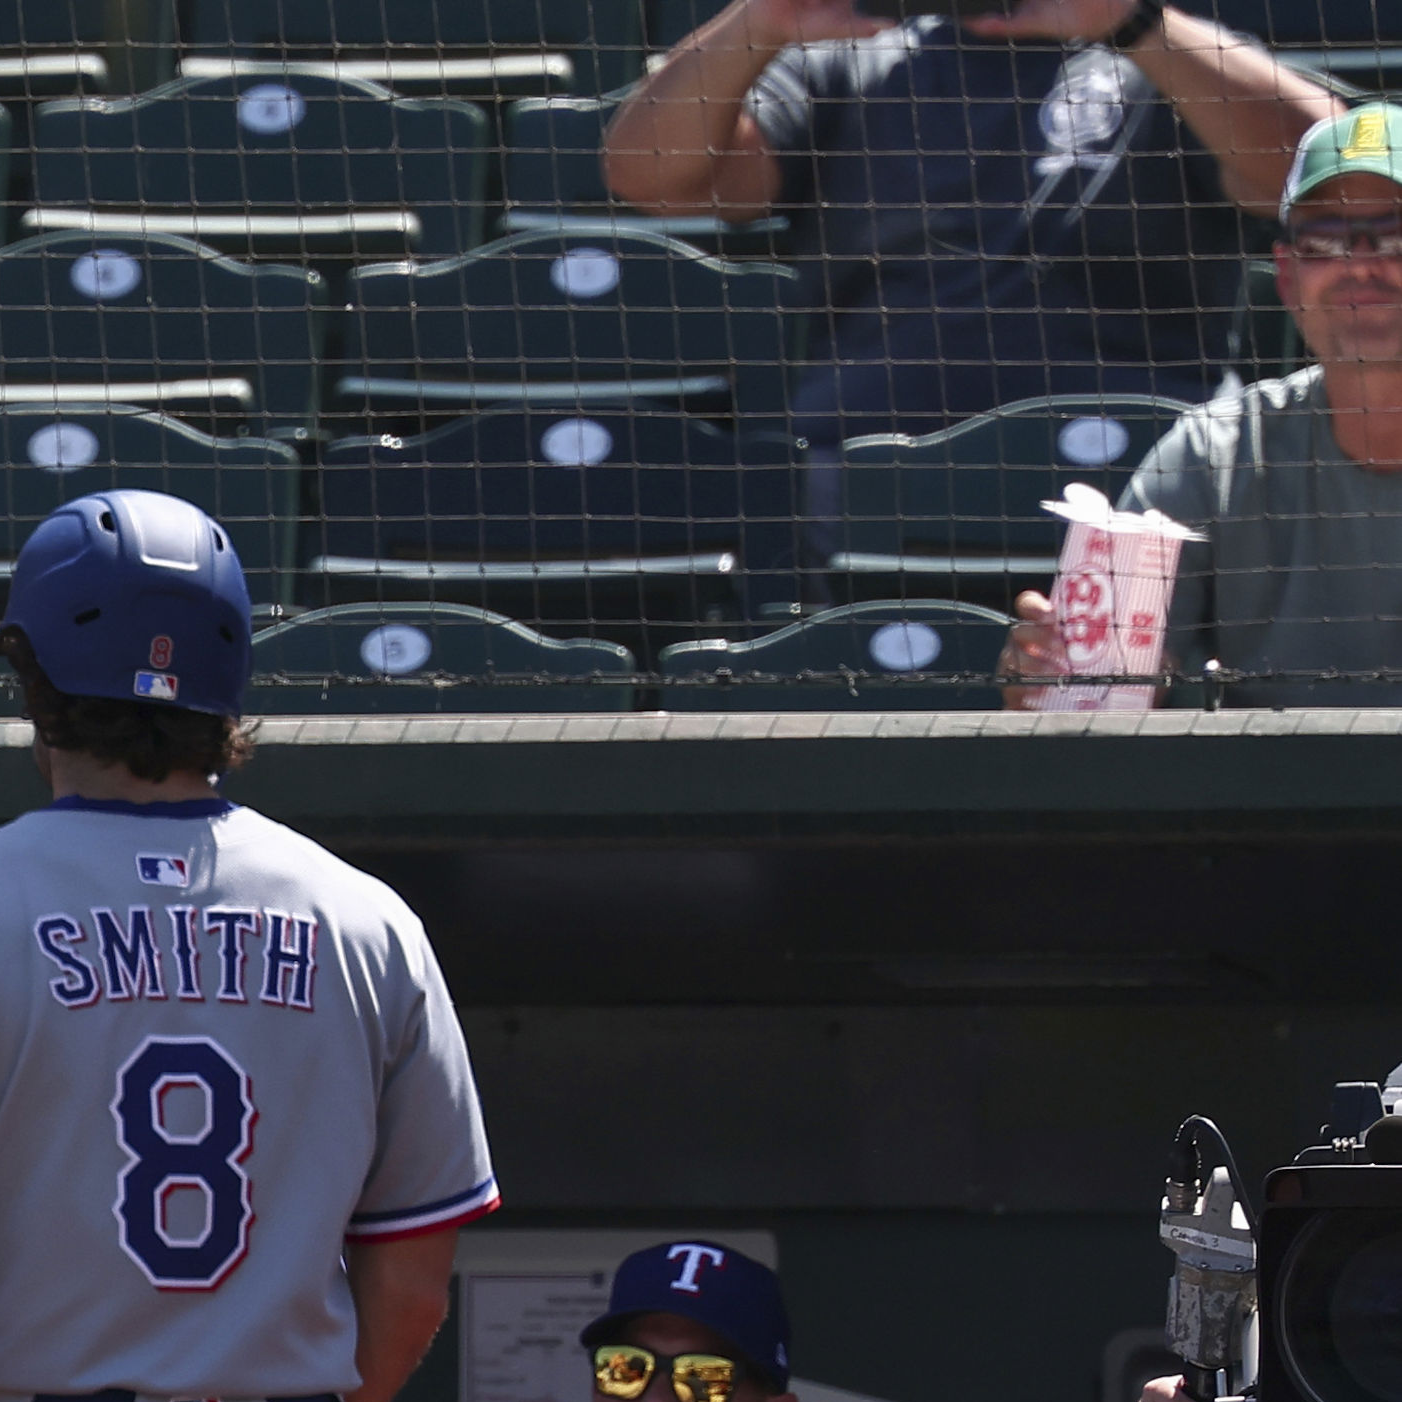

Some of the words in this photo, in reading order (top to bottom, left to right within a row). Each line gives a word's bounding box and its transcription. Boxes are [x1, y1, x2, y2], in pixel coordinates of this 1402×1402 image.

[148, 635, 173, 670] 8
[34, 904, 320, 1011] SMITH
[109, 1034, 259, 1293] 8
[1211, 1237, 1220, 1248] 3
[666, 1243, 726, 1294] T
